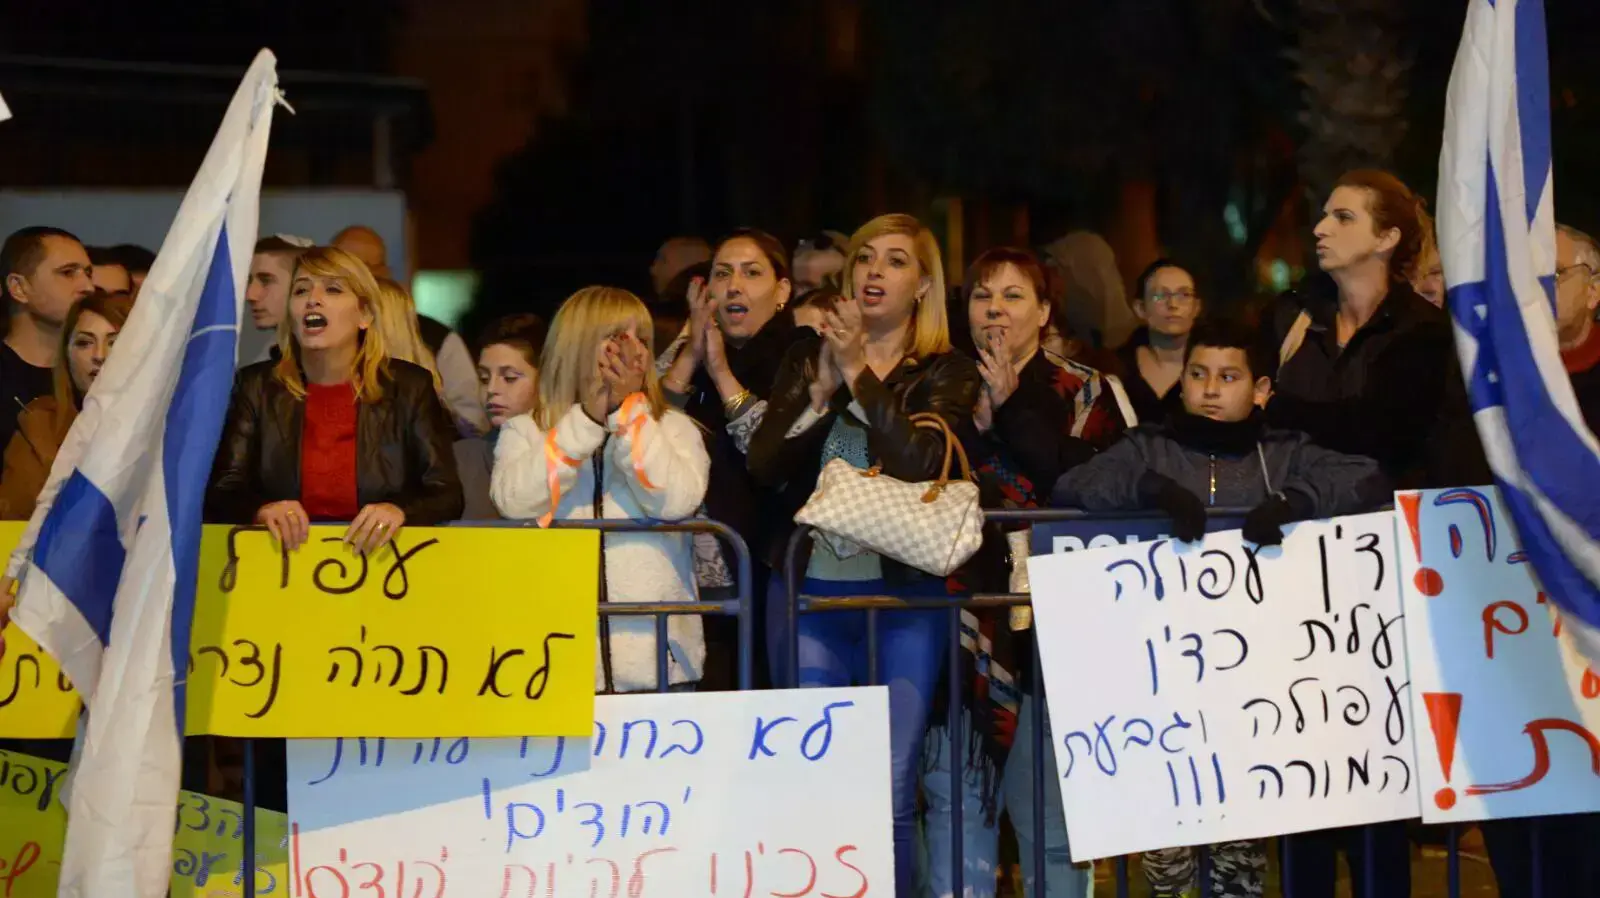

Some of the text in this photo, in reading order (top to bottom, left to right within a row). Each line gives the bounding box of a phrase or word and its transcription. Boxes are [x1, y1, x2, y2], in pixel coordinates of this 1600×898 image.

[219, 525, 439, 600] עפול
[1105, 539, 1264, 604] עפולה
[1294, 603, 1405, 669] עלית
[188, 625, 575, 718] לא תהיה נצר
[748, 701, 855, 761] לא
[1063, 676, 1411, 779] עפולה וגבעת
